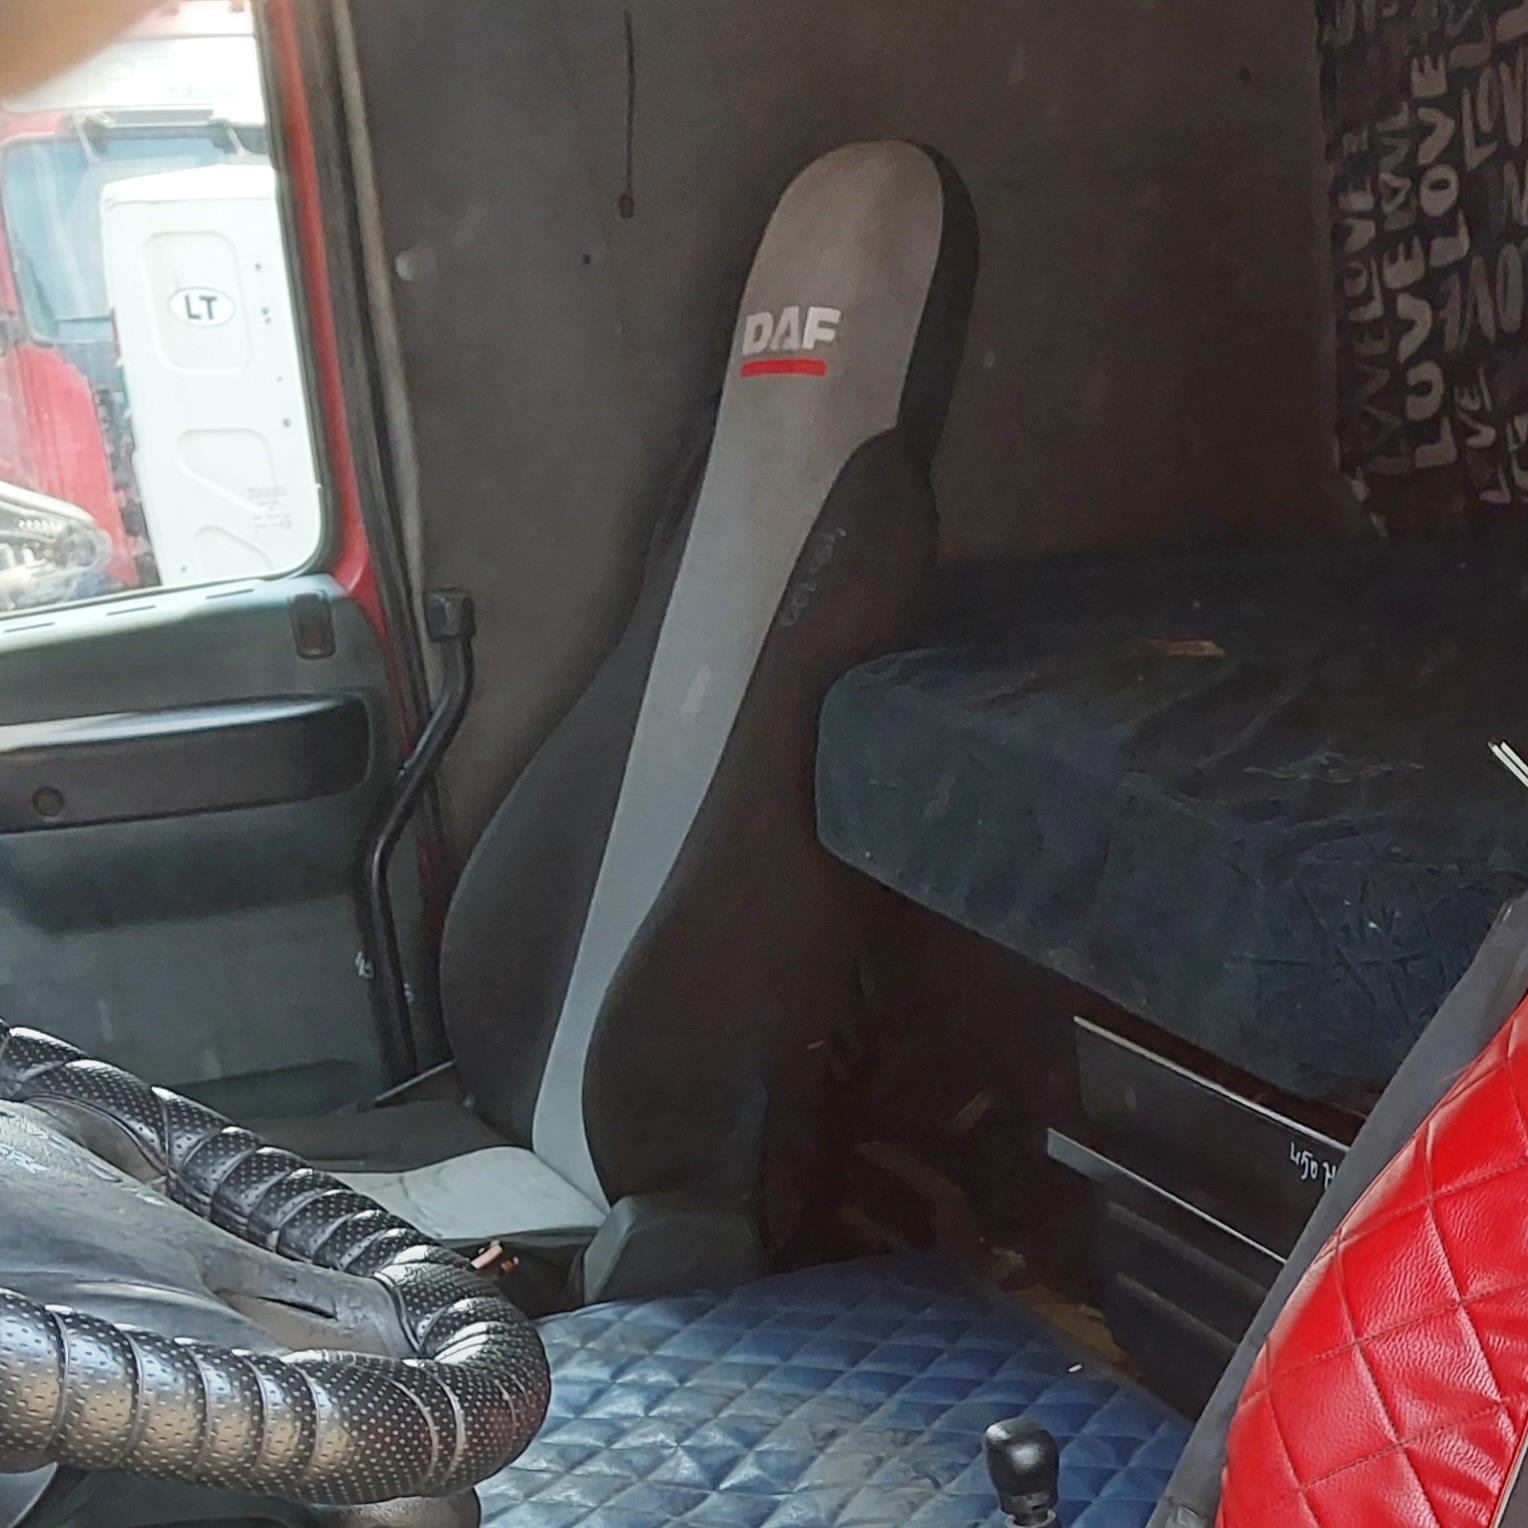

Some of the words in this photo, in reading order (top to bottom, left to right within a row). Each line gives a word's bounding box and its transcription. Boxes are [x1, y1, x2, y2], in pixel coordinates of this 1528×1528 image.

[1410, 51, 1471, 267] LOVE
[184, 294, 219, 321] LT
[742, 305, 841, 356] DAF
[1382, 235, 1458, 468] LOVE
[1289, 1141, 1318, 1180] 450
